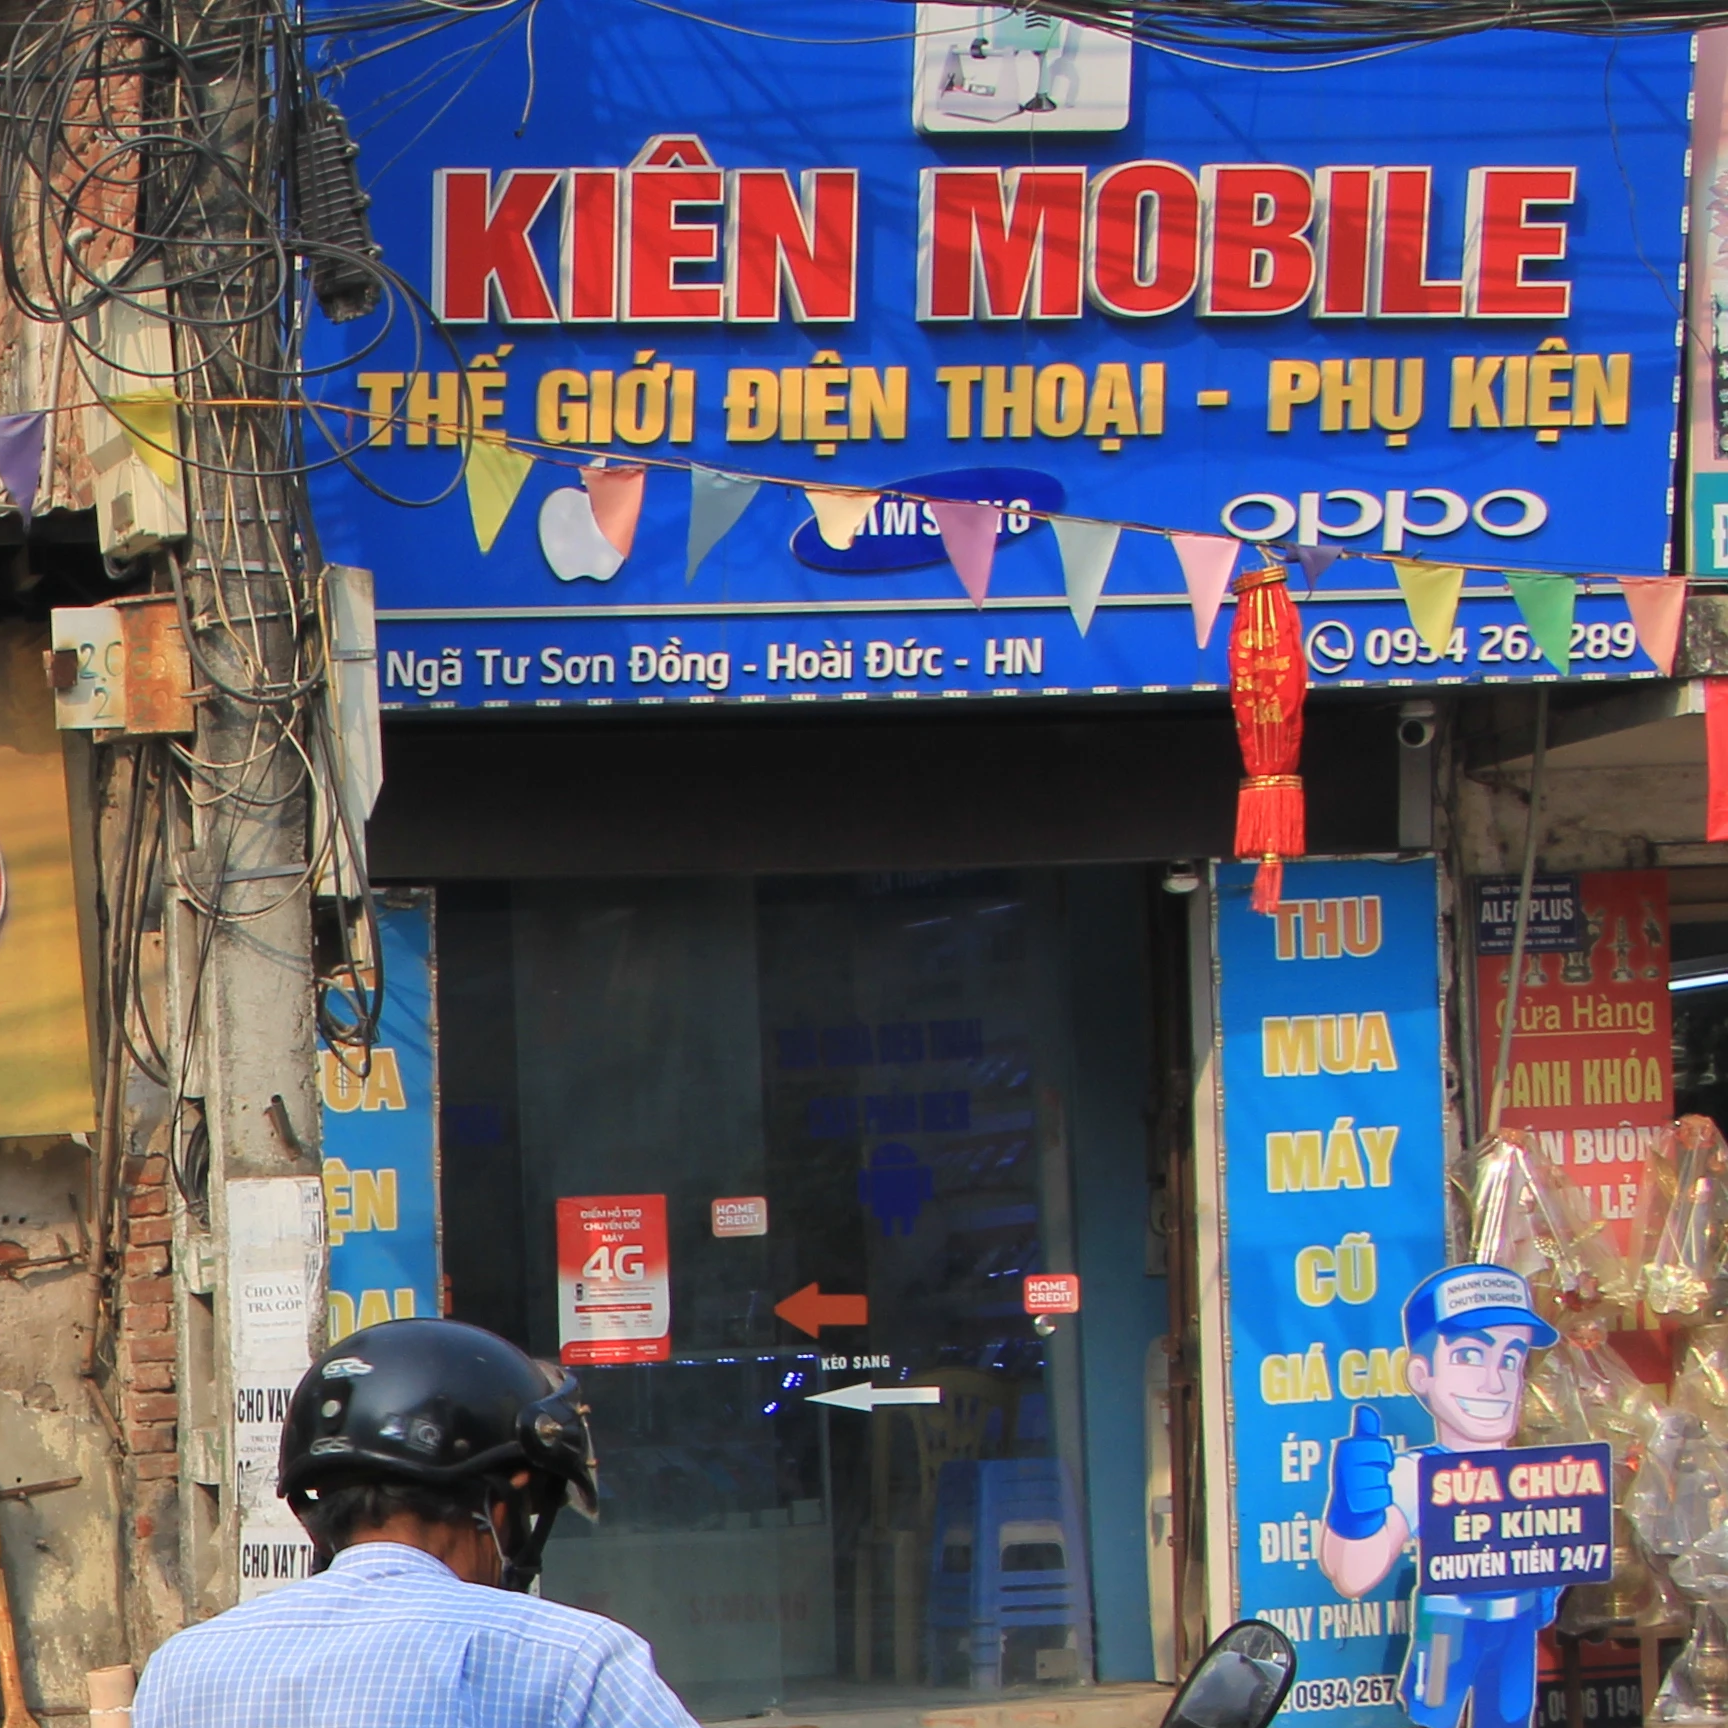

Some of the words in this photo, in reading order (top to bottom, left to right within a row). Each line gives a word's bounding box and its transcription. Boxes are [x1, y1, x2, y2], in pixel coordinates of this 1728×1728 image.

[432, 133, 858, 324] KIÊN
[917, 160, 1578, 321] MOBILE
[357, 344, 514, 447] THẾ
[535, 350, 696, 445] GIỚI
[723, 350, 907, 456] ĐIỆN
[936, 361, 1165, 452] THOẠI
[1267, 357, 1424, 446] PHỤ
[1449, 336, 1631, 443] KIỆN
[1476, 624, 1544, 663] 26
[1566, 621, 1637, 660] 289
[386, 648, 462, 697] Ngã
[476, 648, 531, 686] Tư
[540, 647, 615, 685] Sơn
[628, 637, 731, 691] Đồng
[766, 640, 853, 681] Hoài
[863, 638, 943, 680] Đức
[984, 637, 1043, 676] HN
[1266, 895, 1382, 960] THU
[1529, 898, 1574, 921] PLUS
[1572, 993, 1656, 1035] Hàng
[1261, 1012, 1398, 1078] MUA
[1582, 1047, 1664, 1106] KHÓA
[1266, 1116, 1400, 1194] MÁY
[716, 1203, 757, 1215] HOME
[716, 1214, 760, 1226] CREDIT
[582, 1245, 645, 1283] 4G
[1294, 1232, 1378, 1303] CŨ
[1028, 1280, 1068, 1291] HOME
[1028, 1291, 1072, 1303] CREDIT
[821, 1353, 848, 1371] KÉO
[852, 1354, 891, 1370] SANG
[1260, 1342, 1333, 1406] GIÁ
[237, 1388, 264, 1423] CHO
[1281, 1432, 1321, 1484] ÉP
[1431, 1460, 1504, 1507] SỬA
[1454, 1509, 1492, 1543] ÉP
[1501, 1503, 1582, 1539] KÍNH
[242, 1543, 269, 1578] CHO
[272, 1543, 297, 1578] VAY
[1560, 1544, 1607, 1573] 24/7
[1294, 1677, 1349, 1711] 0934
[1353, 1671, 1397, 1705] 267
